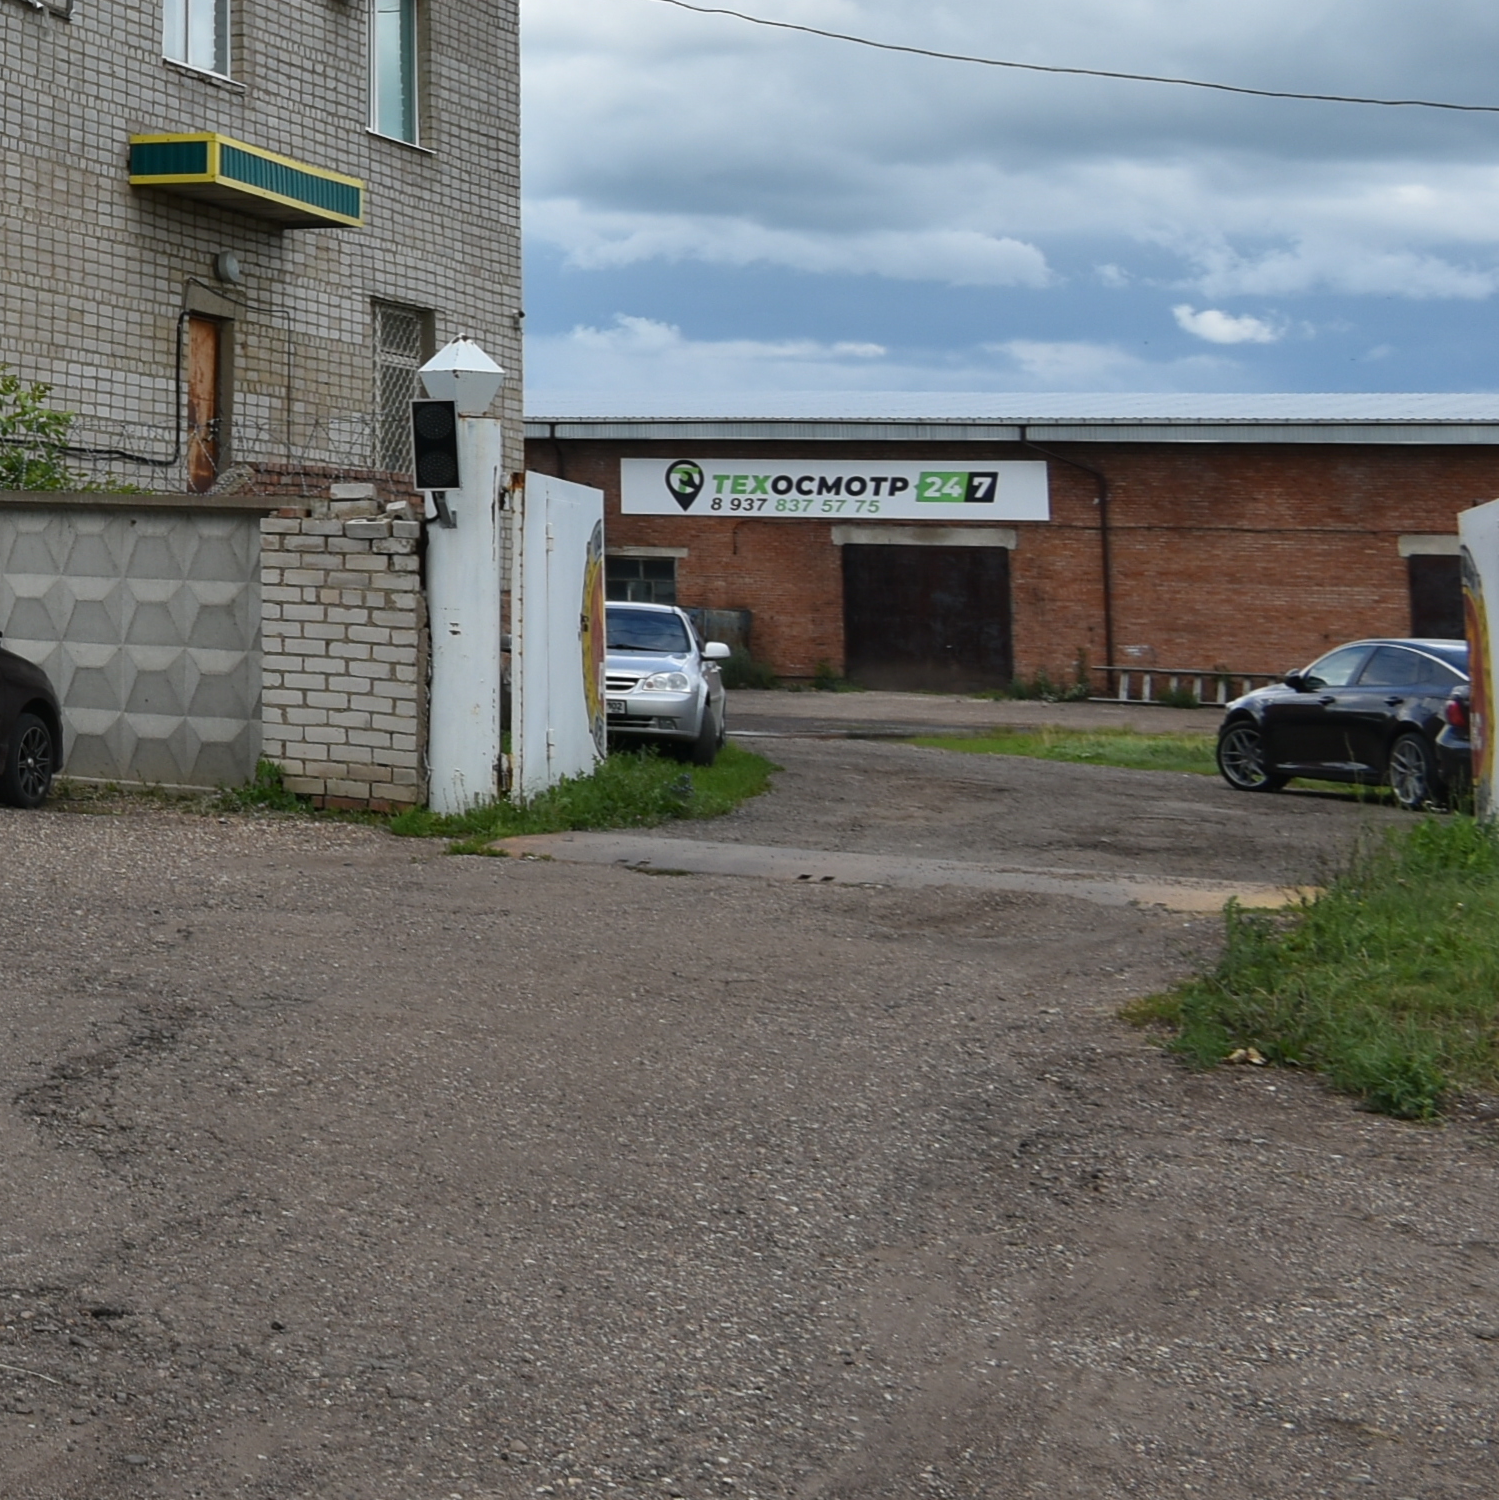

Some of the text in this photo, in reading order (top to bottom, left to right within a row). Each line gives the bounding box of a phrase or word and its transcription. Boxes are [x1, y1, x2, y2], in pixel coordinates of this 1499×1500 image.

[712, 474, 909, 497] ТЕХОСМОТР
[710, 497, 880, 513] 8 937 837 57 75
